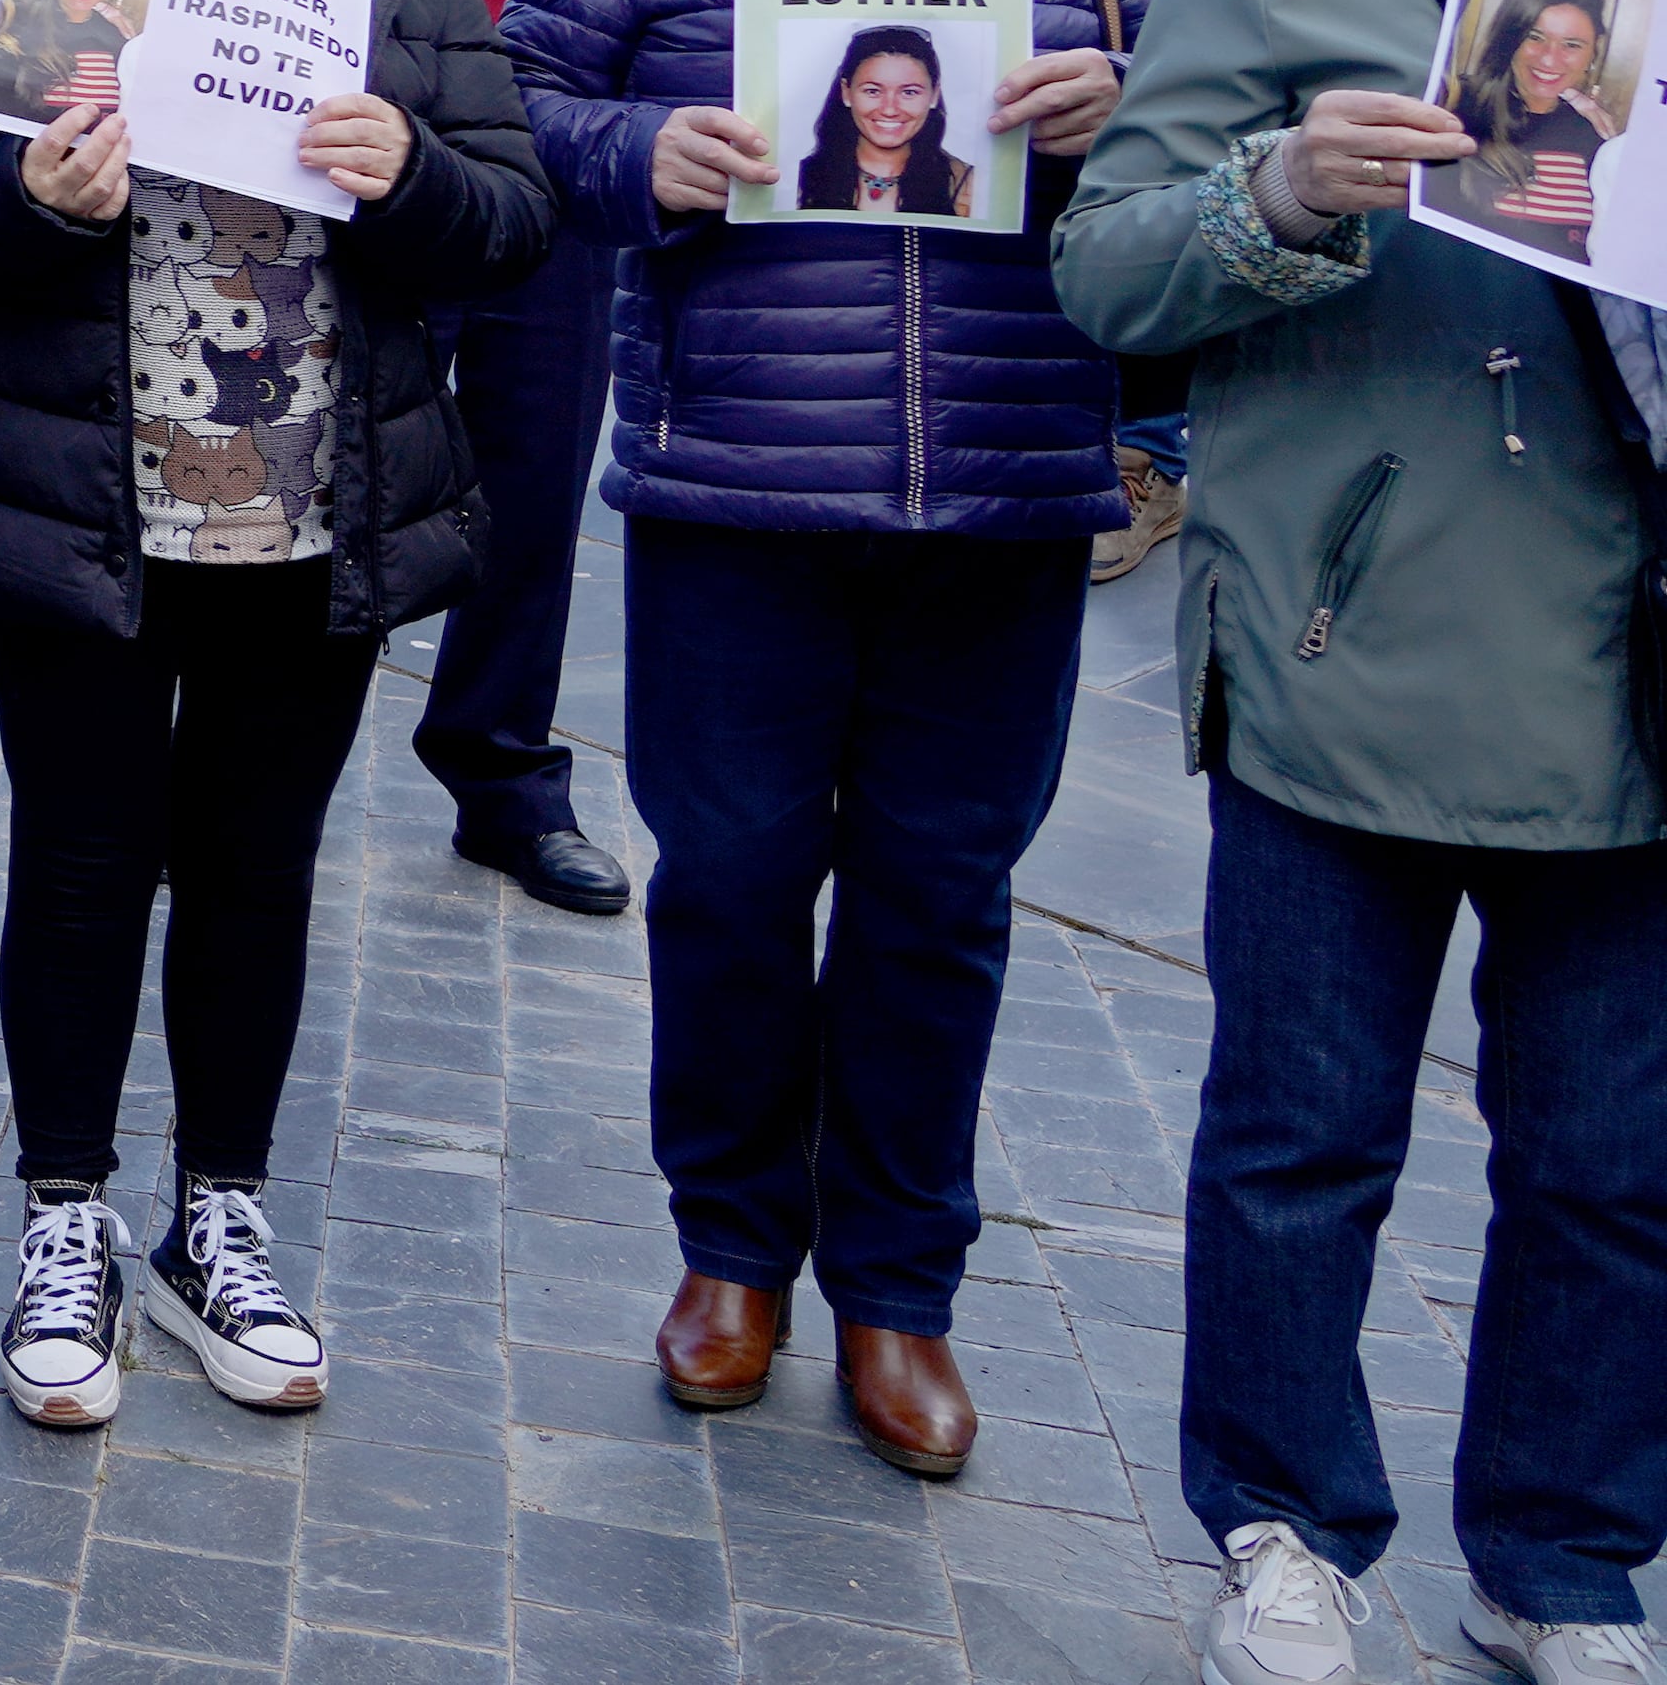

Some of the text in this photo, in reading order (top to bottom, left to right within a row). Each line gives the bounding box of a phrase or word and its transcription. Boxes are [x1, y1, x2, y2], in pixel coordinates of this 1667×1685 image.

[212, 38, 314, 79] NO TE
[194, 73, 314, 116] OLVIDA
